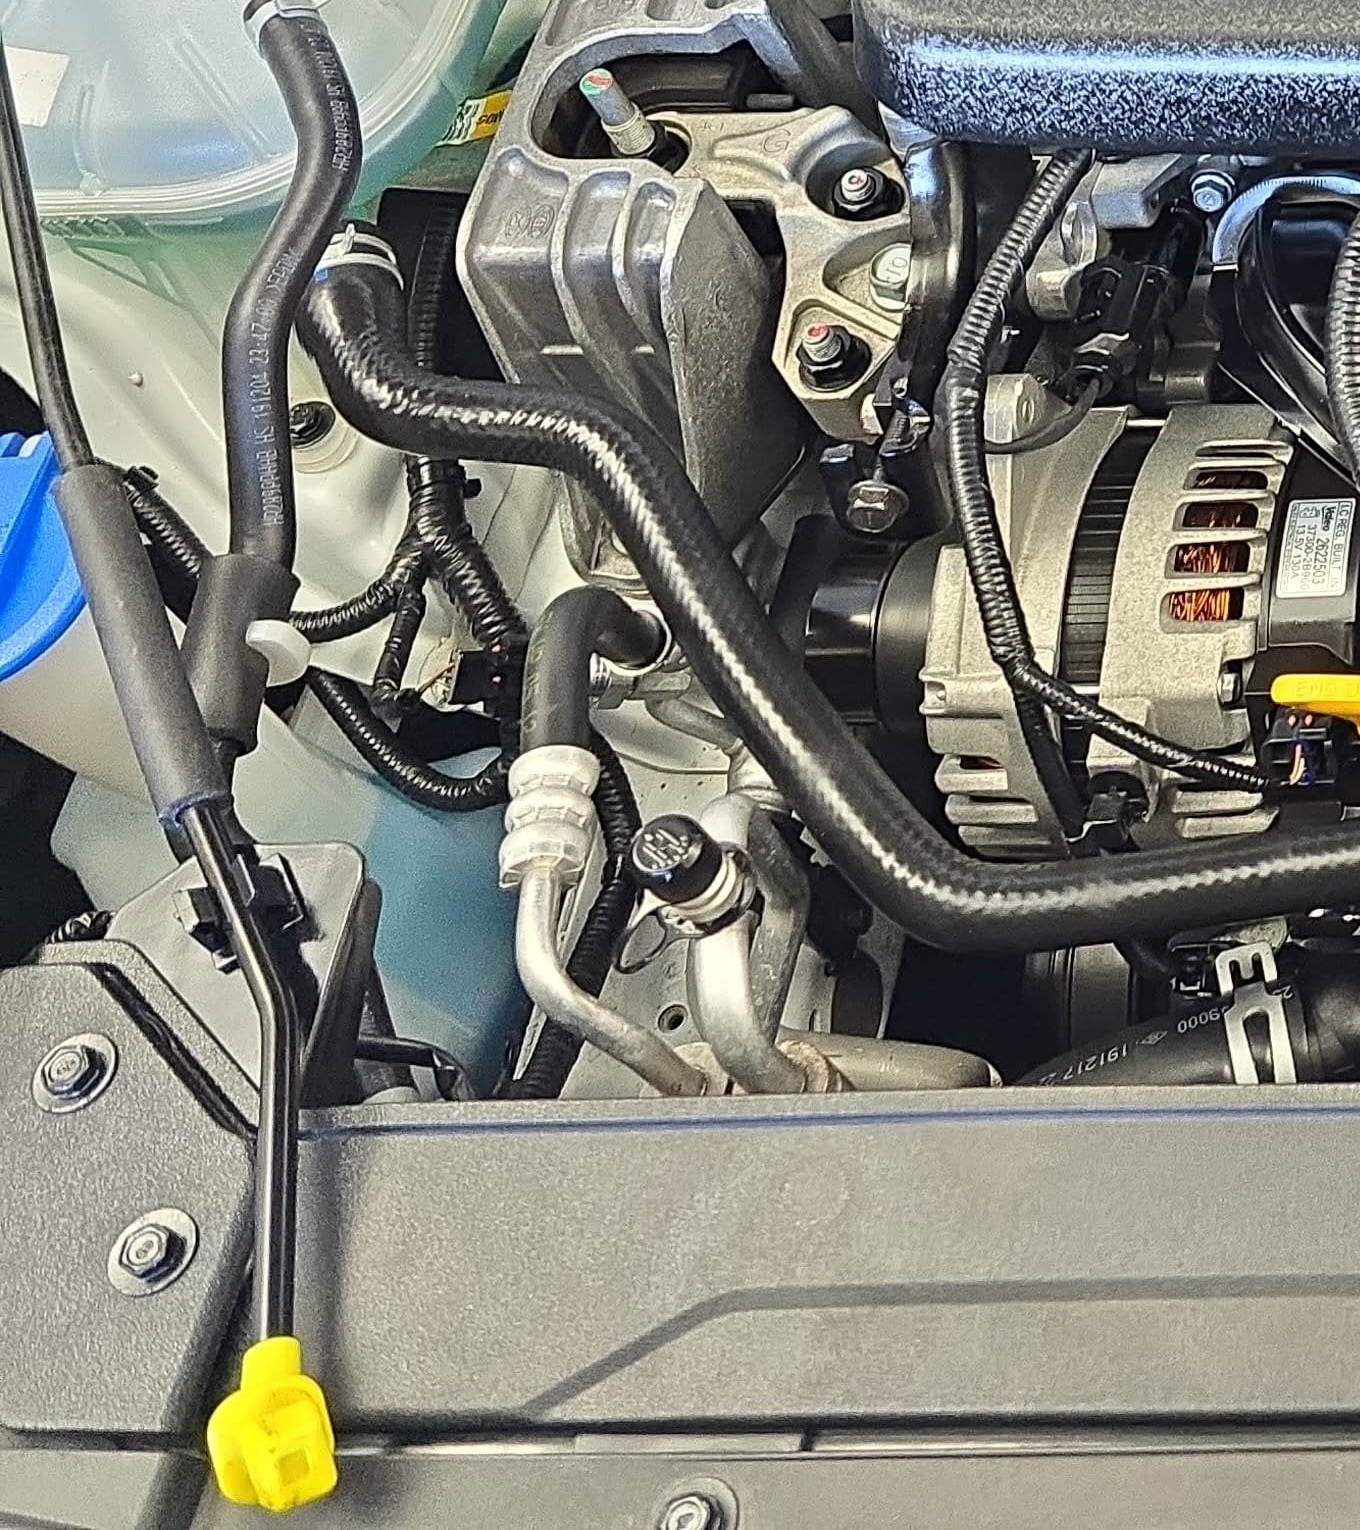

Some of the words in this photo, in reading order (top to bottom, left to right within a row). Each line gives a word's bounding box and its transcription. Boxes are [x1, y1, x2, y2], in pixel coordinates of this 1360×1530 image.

[1323, 506, 1337, 532] Valeo
[1312, 538, 1330, 585] 2622503
[1332, 543, 1344, 570] BUILT
[1062, 1043, 1129, 1081] 191217
